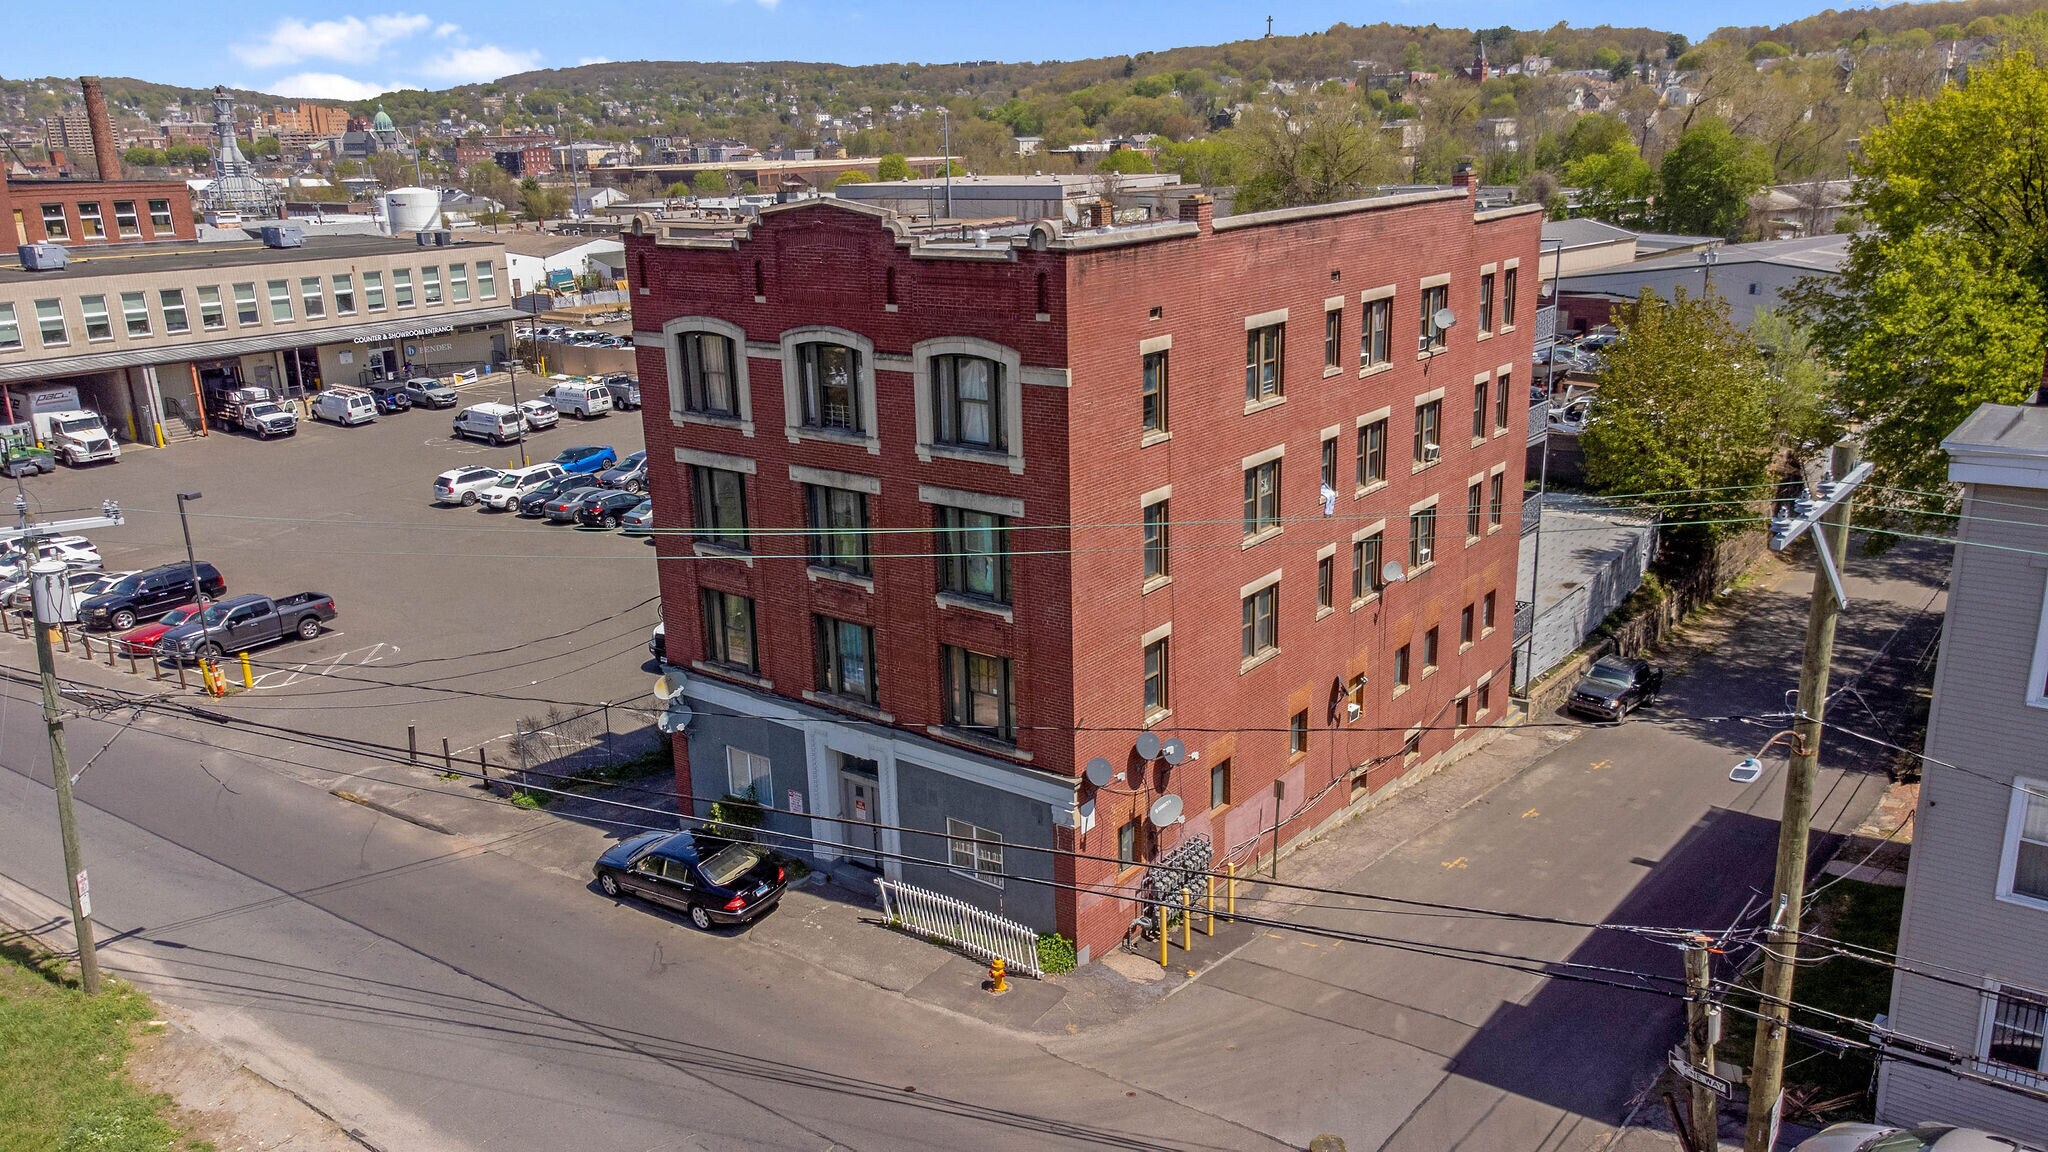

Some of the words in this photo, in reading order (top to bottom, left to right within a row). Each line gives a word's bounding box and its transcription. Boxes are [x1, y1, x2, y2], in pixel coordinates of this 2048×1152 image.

[354, 334, 382, 344] COUNTER
[388, 329, 424, 340] SHOWROOM
[424, 325, 454, 335] ENTRANCE
[1704, 1075, 1724, 1090] WAY
